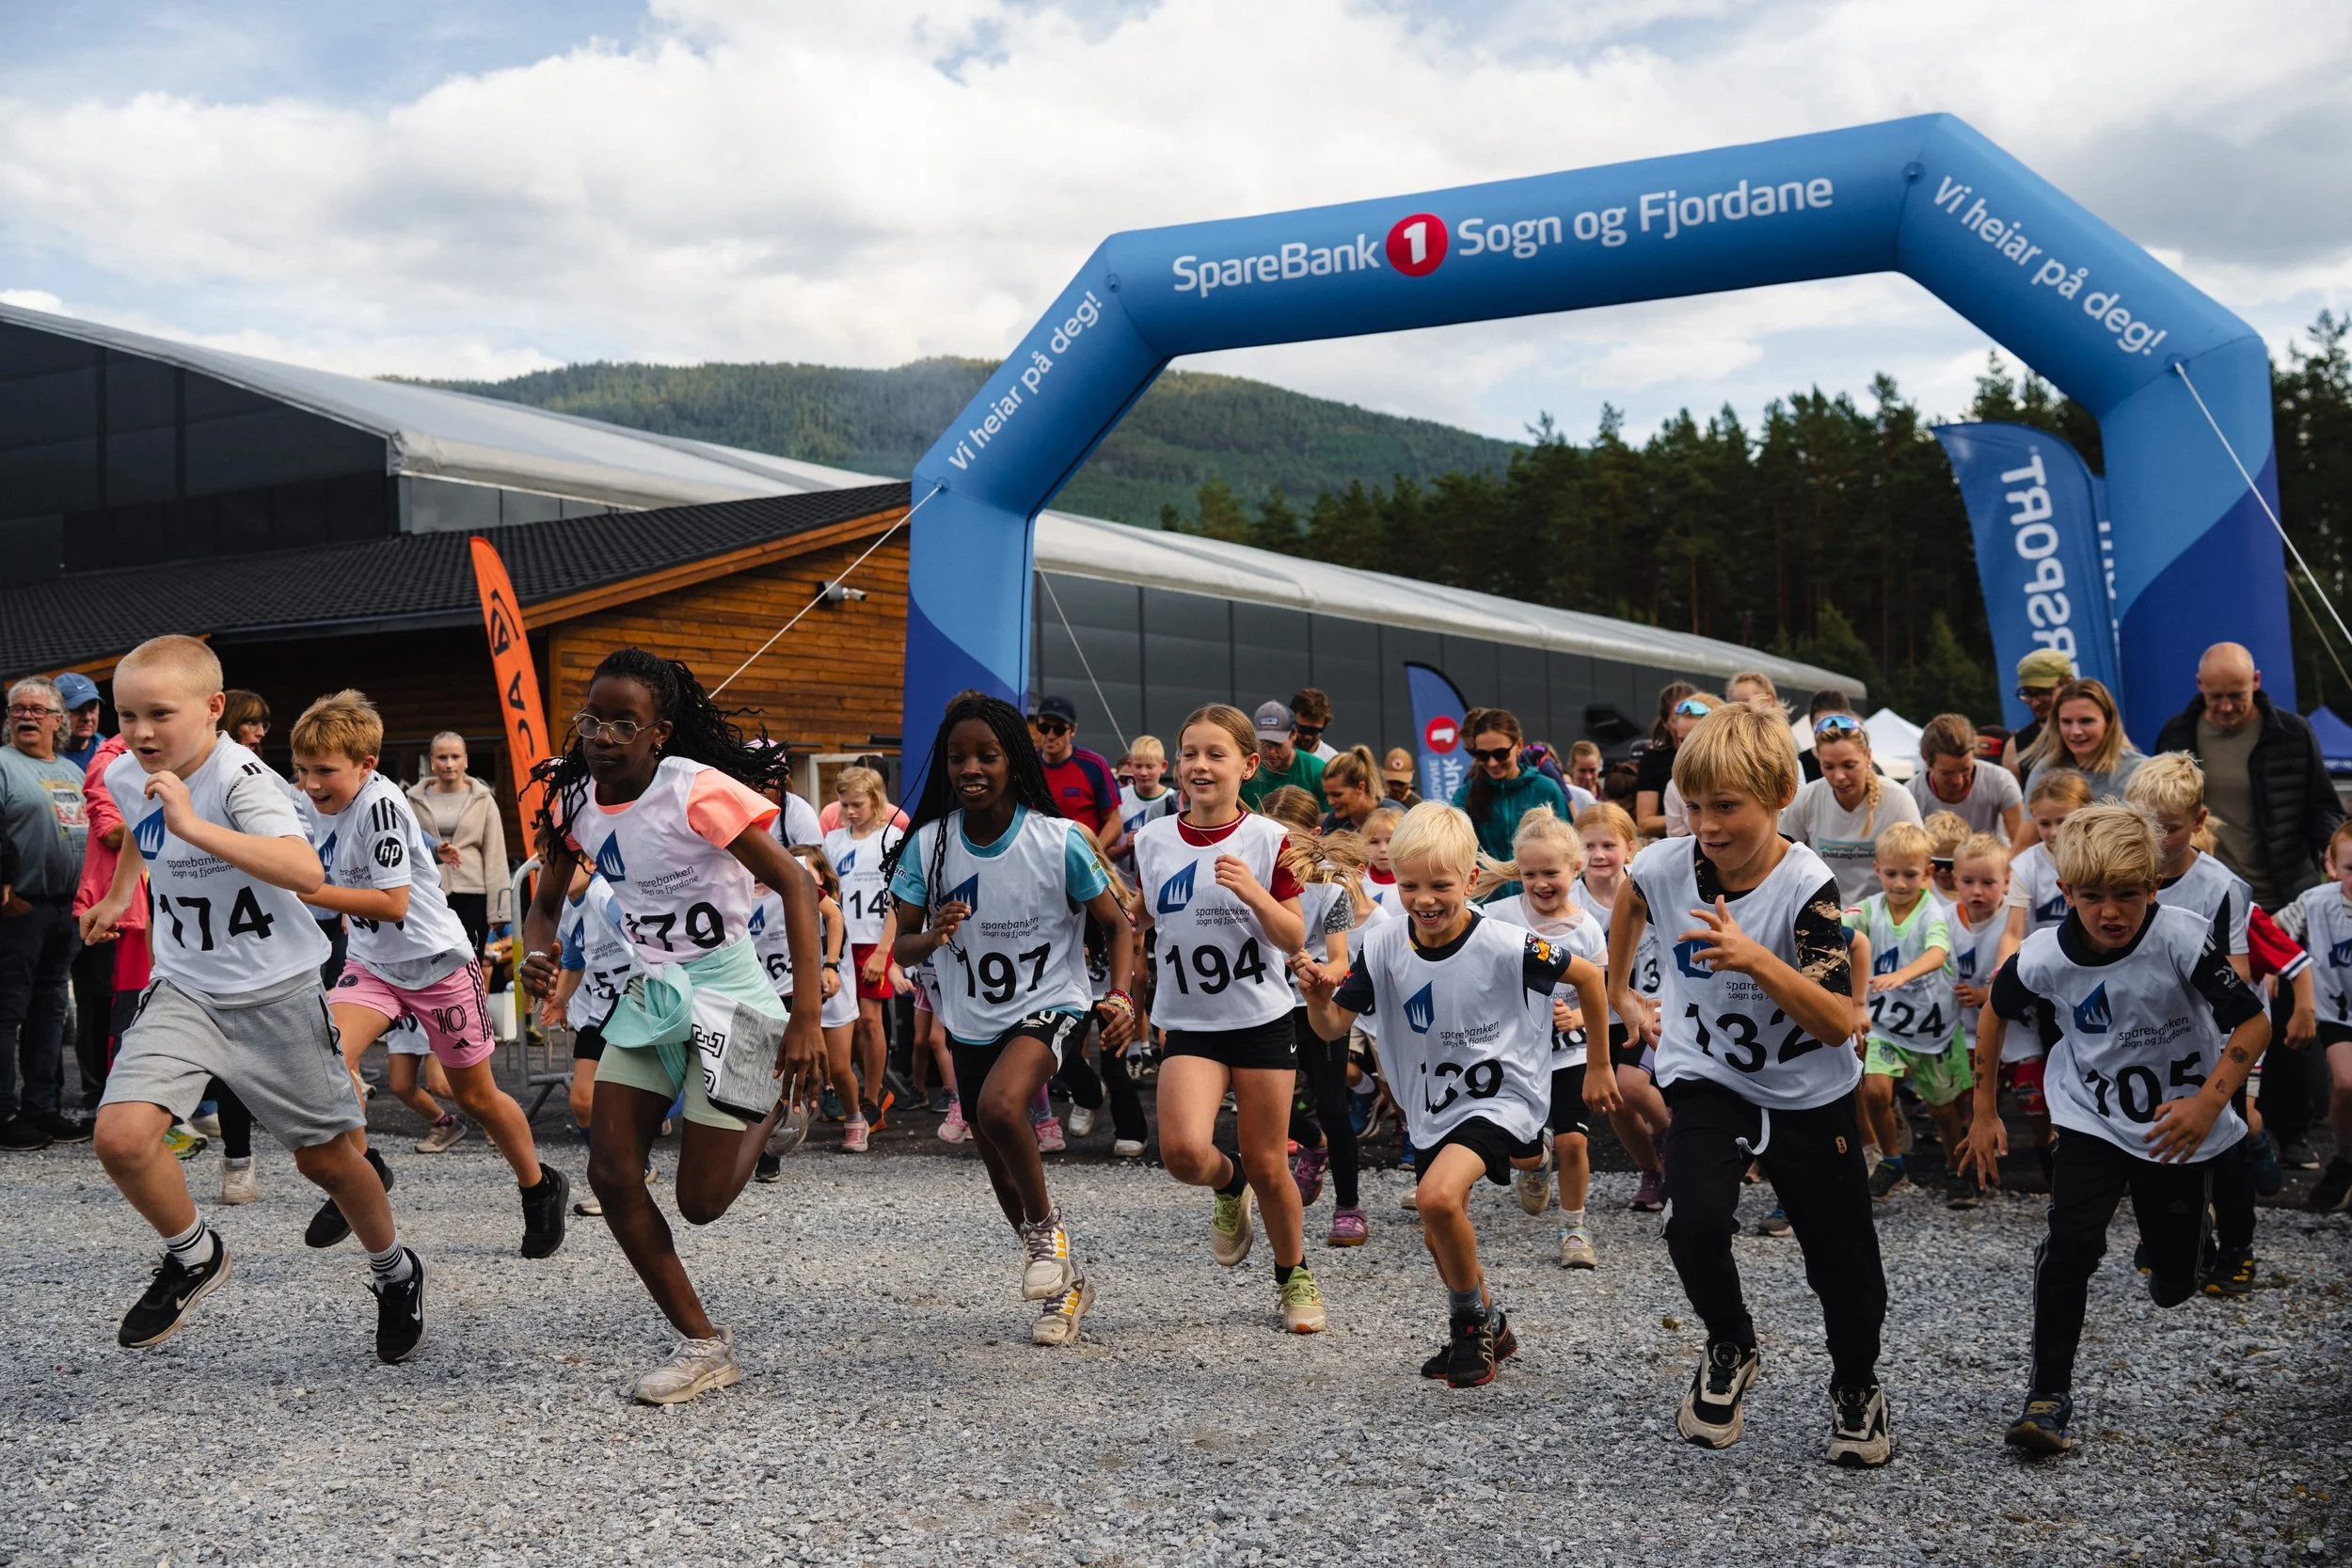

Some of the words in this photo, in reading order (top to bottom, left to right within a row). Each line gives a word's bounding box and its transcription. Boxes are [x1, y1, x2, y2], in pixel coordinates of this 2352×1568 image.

[1173, 233, 1381, 297] SpareBank
[1458, 217, 1563, 259] Sogn
[1574, 206, 1627, 246] og
[1639, 177, 1834, 239] Fjordane
[1933, 175, 1972, 214] Vi
[1961, 198, 2042, 266] heiar
[2031, 258, 2089, 300] på
[2083, 292, 2168, 356] deg!
[969, 386, 1023, 450] heiar
[1021, 351, 1053, 394] på
[1051, 291, 1103, 354] deg!
[377, 837, 402, 867] hp
[171, 870, 187, 879] sogn
[635, 865, 694, 888] parebanken
[665, 875, 699, 895] fjordane
[159, 886, 274, 951] 174
[981, 917, 1039, 930] sparebanken
[1196, 907, 1249, 918] sparebanken
[957, 942, 1051, 1005] 197
[1165, 937, 1266, 994] 194
[1725, 981, 1758, 992] spare
[431, 1005, 467, 1034] 10
[1869, 995, 1946, 1037] 124
[2119, 1016, 2188, 1042] sparebanken
[1685, 1002, 1822, 1072] 132
[2145, 1037, 2156, 1046] og
[2084, 1052, 2205, 1124] 105
